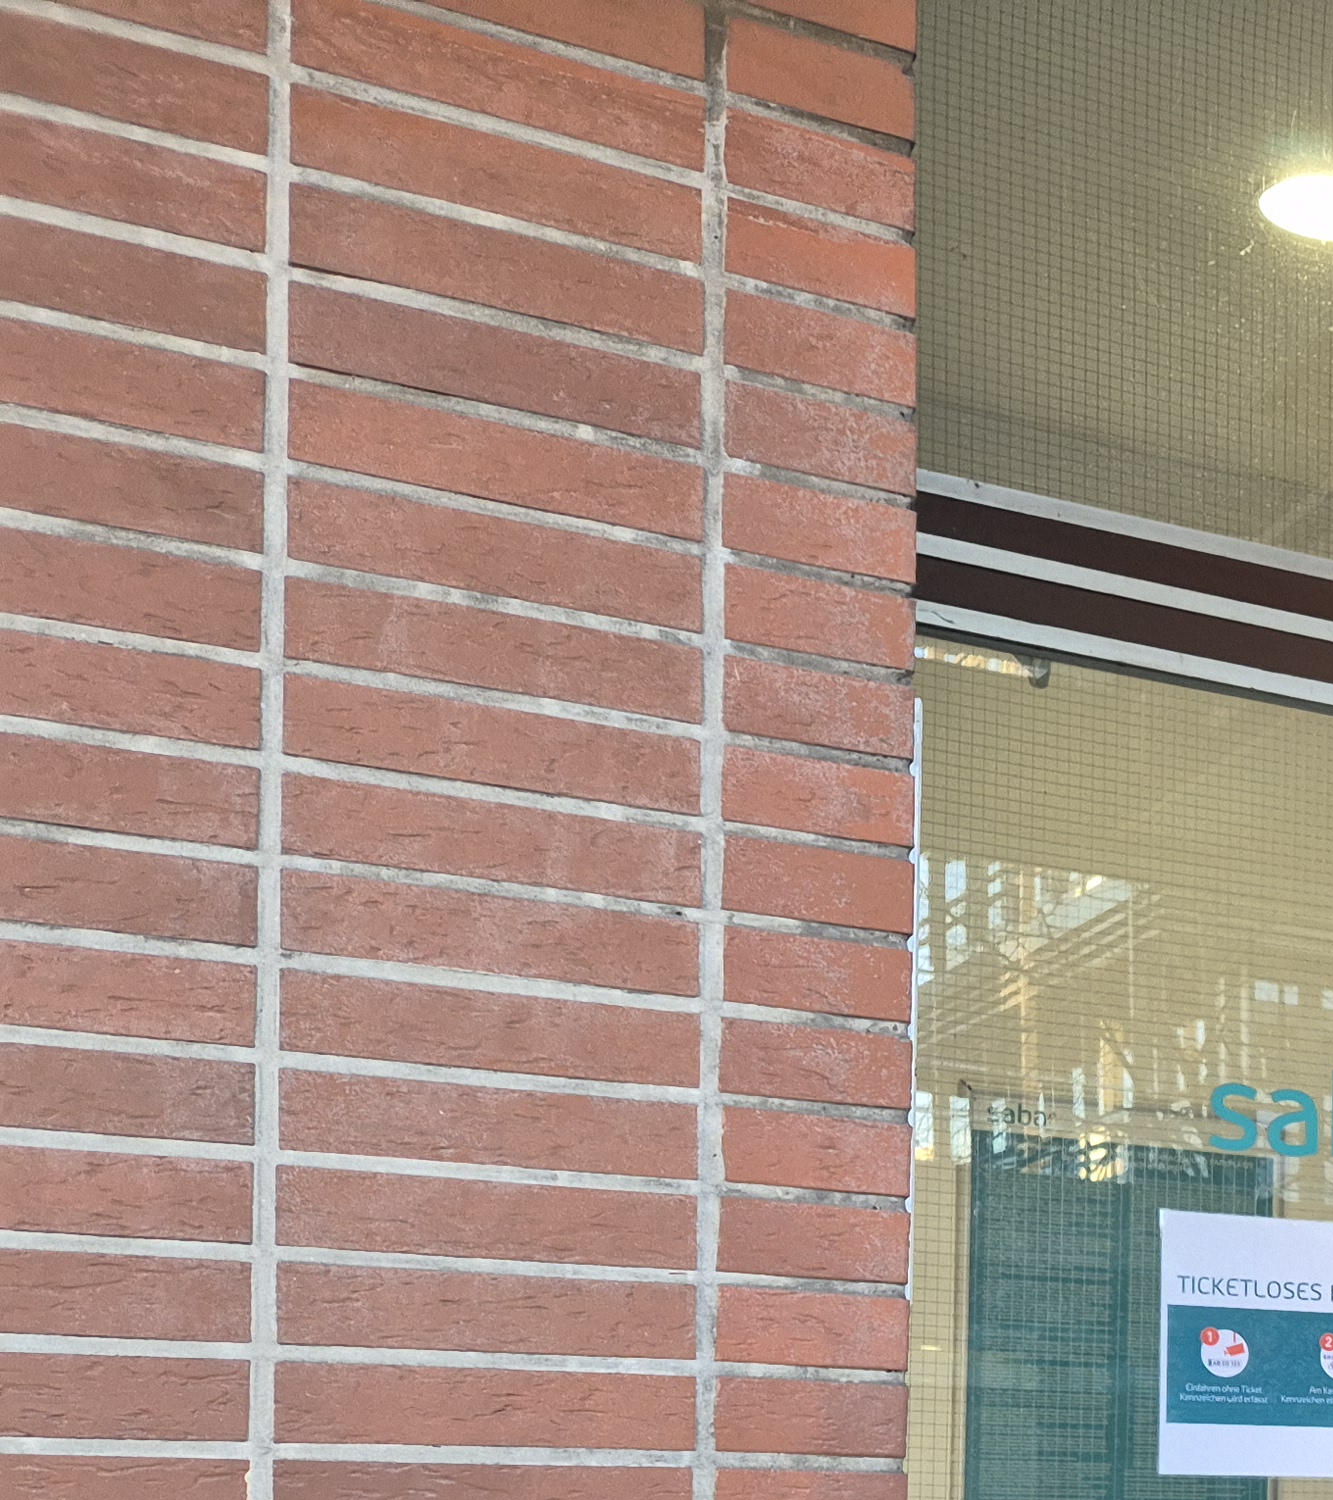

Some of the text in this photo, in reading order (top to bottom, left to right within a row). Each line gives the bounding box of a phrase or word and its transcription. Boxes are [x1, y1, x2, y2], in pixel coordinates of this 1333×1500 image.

[1177, 1275, 1322, 1302] TICKETLOSES
[1207, 1331, 1213, 1343] 1
[1324, 1335, 1333, 1348] 2
[1185, 1383, 1263, 1394] Einfahren ohne Ticket
[1309, 1386, 1323, 1395] Am
[1180, 1393, 1226, 1403] Kennzeichen
